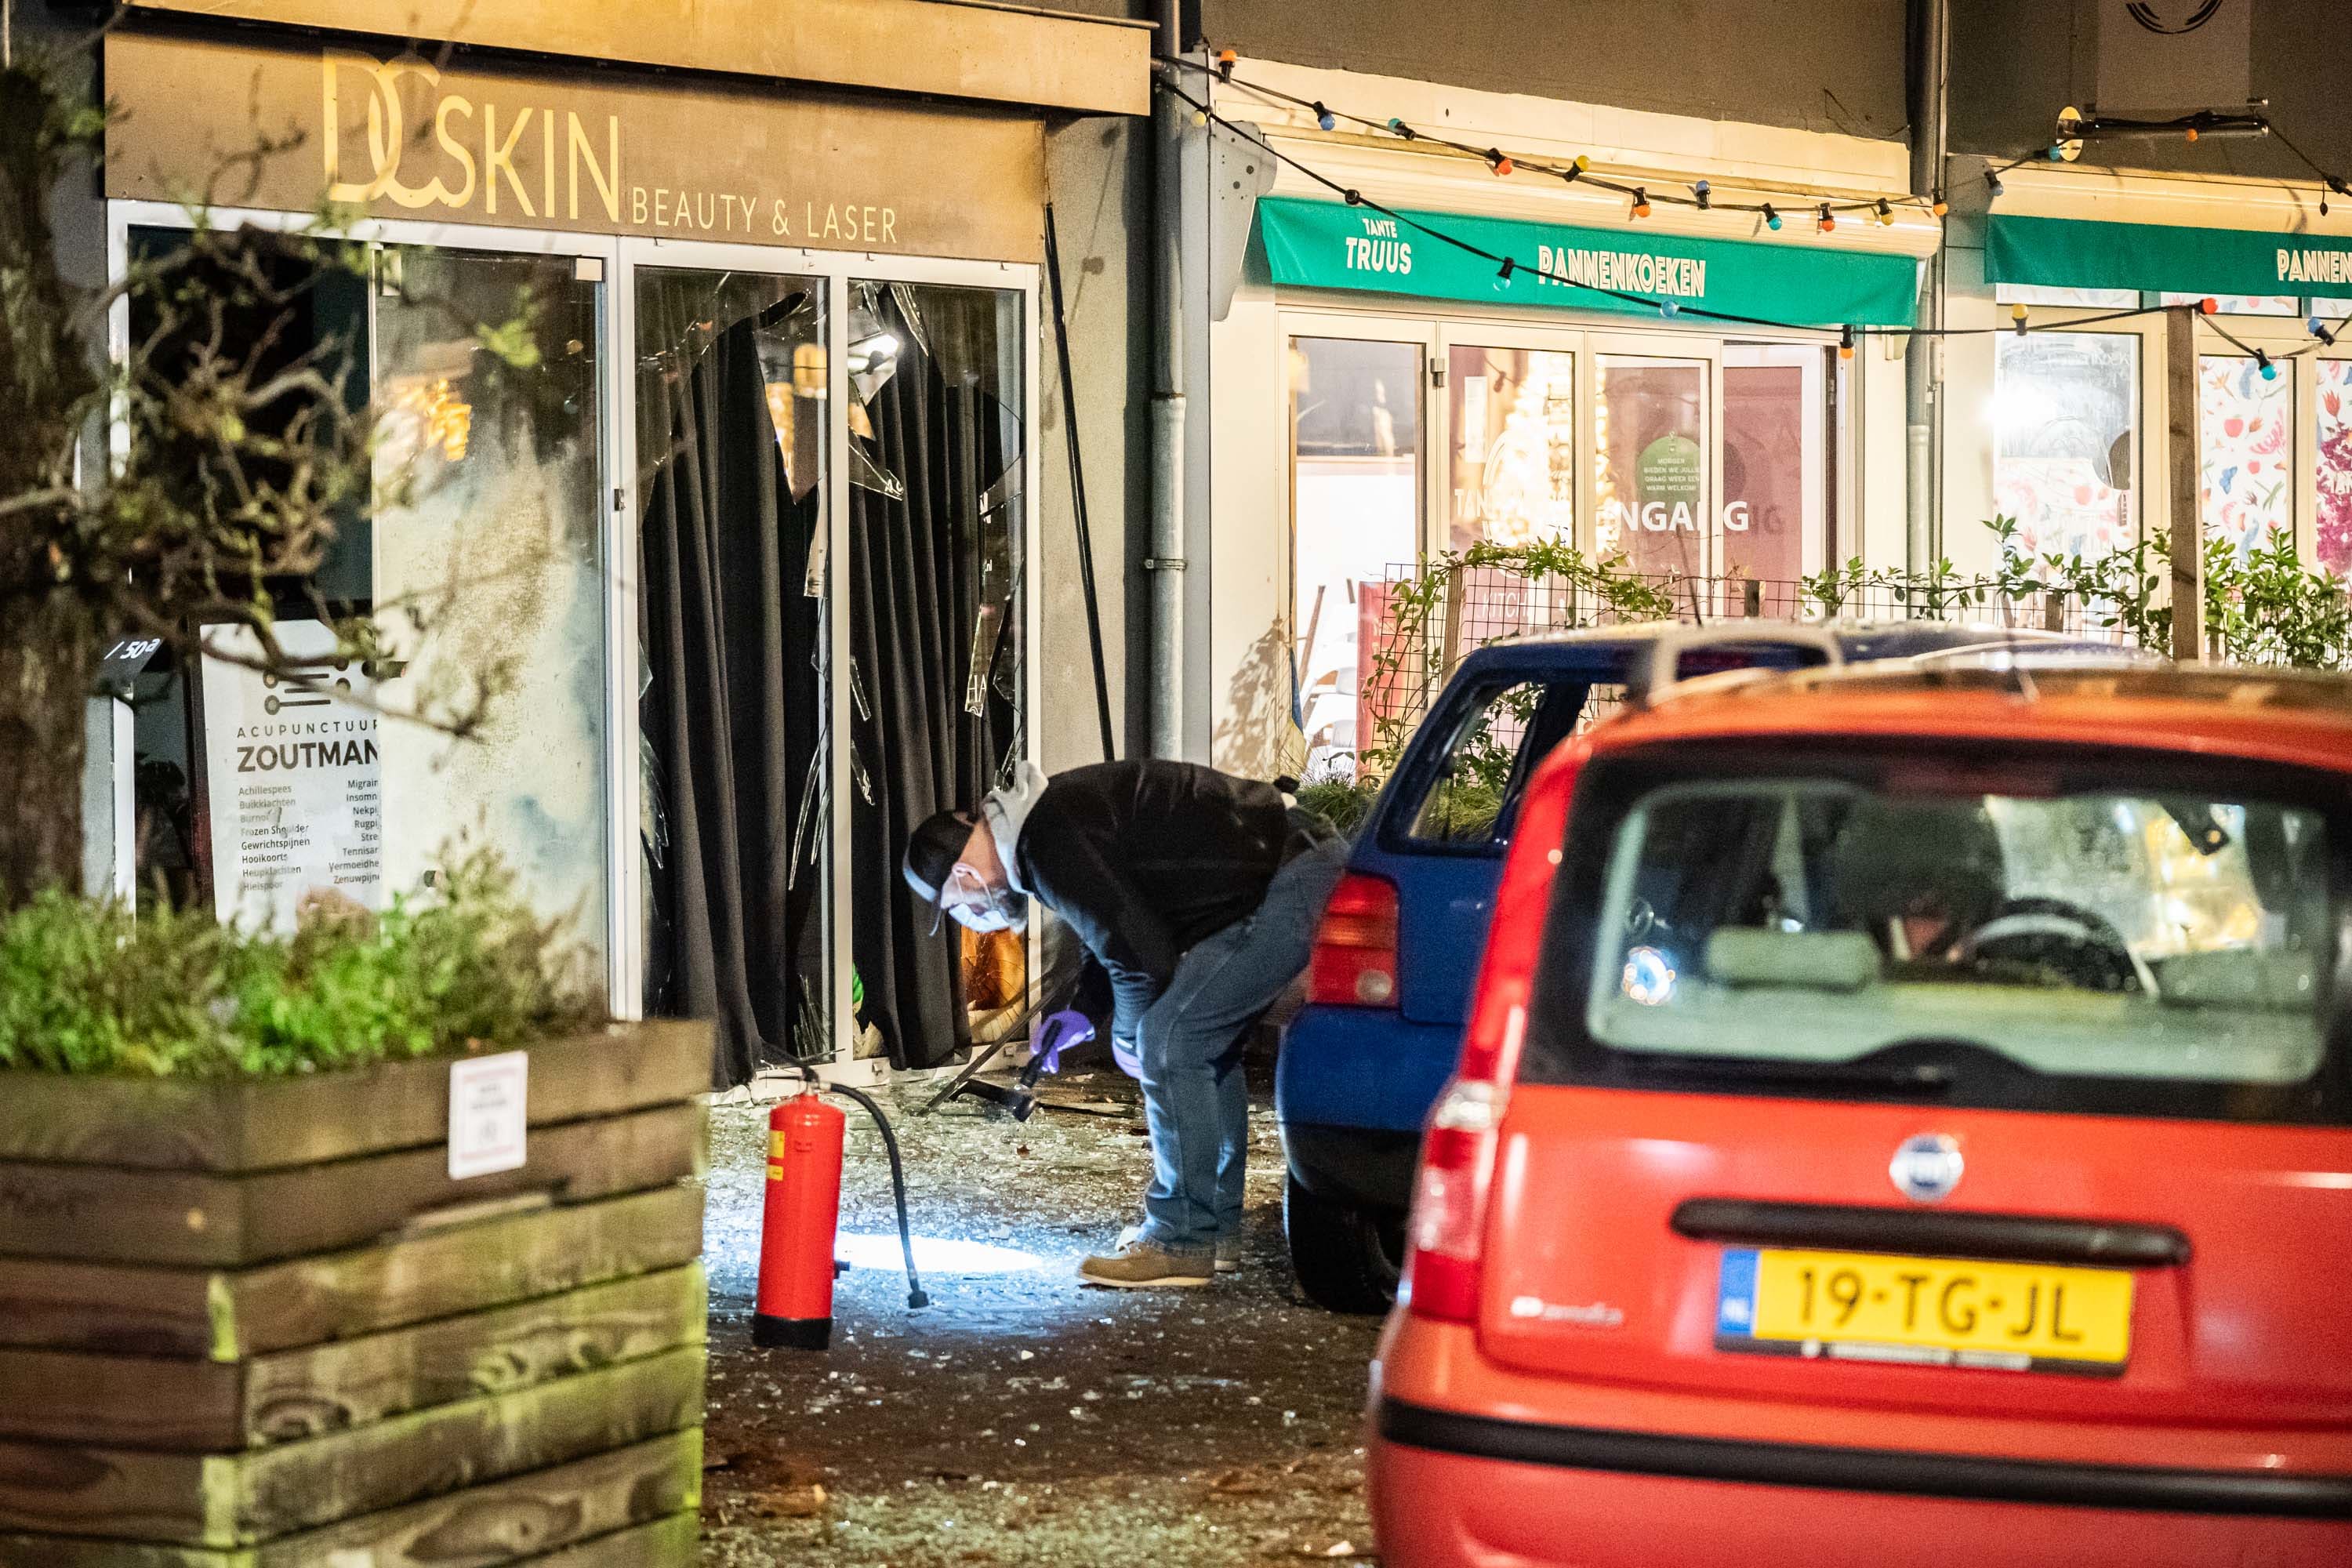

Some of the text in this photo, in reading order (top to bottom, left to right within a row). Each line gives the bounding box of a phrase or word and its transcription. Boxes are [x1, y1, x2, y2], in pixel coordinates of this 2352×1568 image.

[631, 186, 898, 245] BEAUTY & LASER
[1362, 217, 1398, 239] TANTE
[1345, 237, 1412, 275] TRUUS
[2277, 248, 2352, 284] PANNEN
[1537, 245, 1707, 298] PANNENKOEKEN
[237, 739, 379, 773] ZOUTMAN
[238, 785, 292, 797] Achillespees
[353, 805, 378, 816] Nekpi
[354, 819, 379, 830] Rugpi
[241, 837, 310, 850] Gewrichtspijnen
[333, 872, 380, 884] Zenuwpijn
[1799, 1268, 2082, 1343] 19-TG-JL
